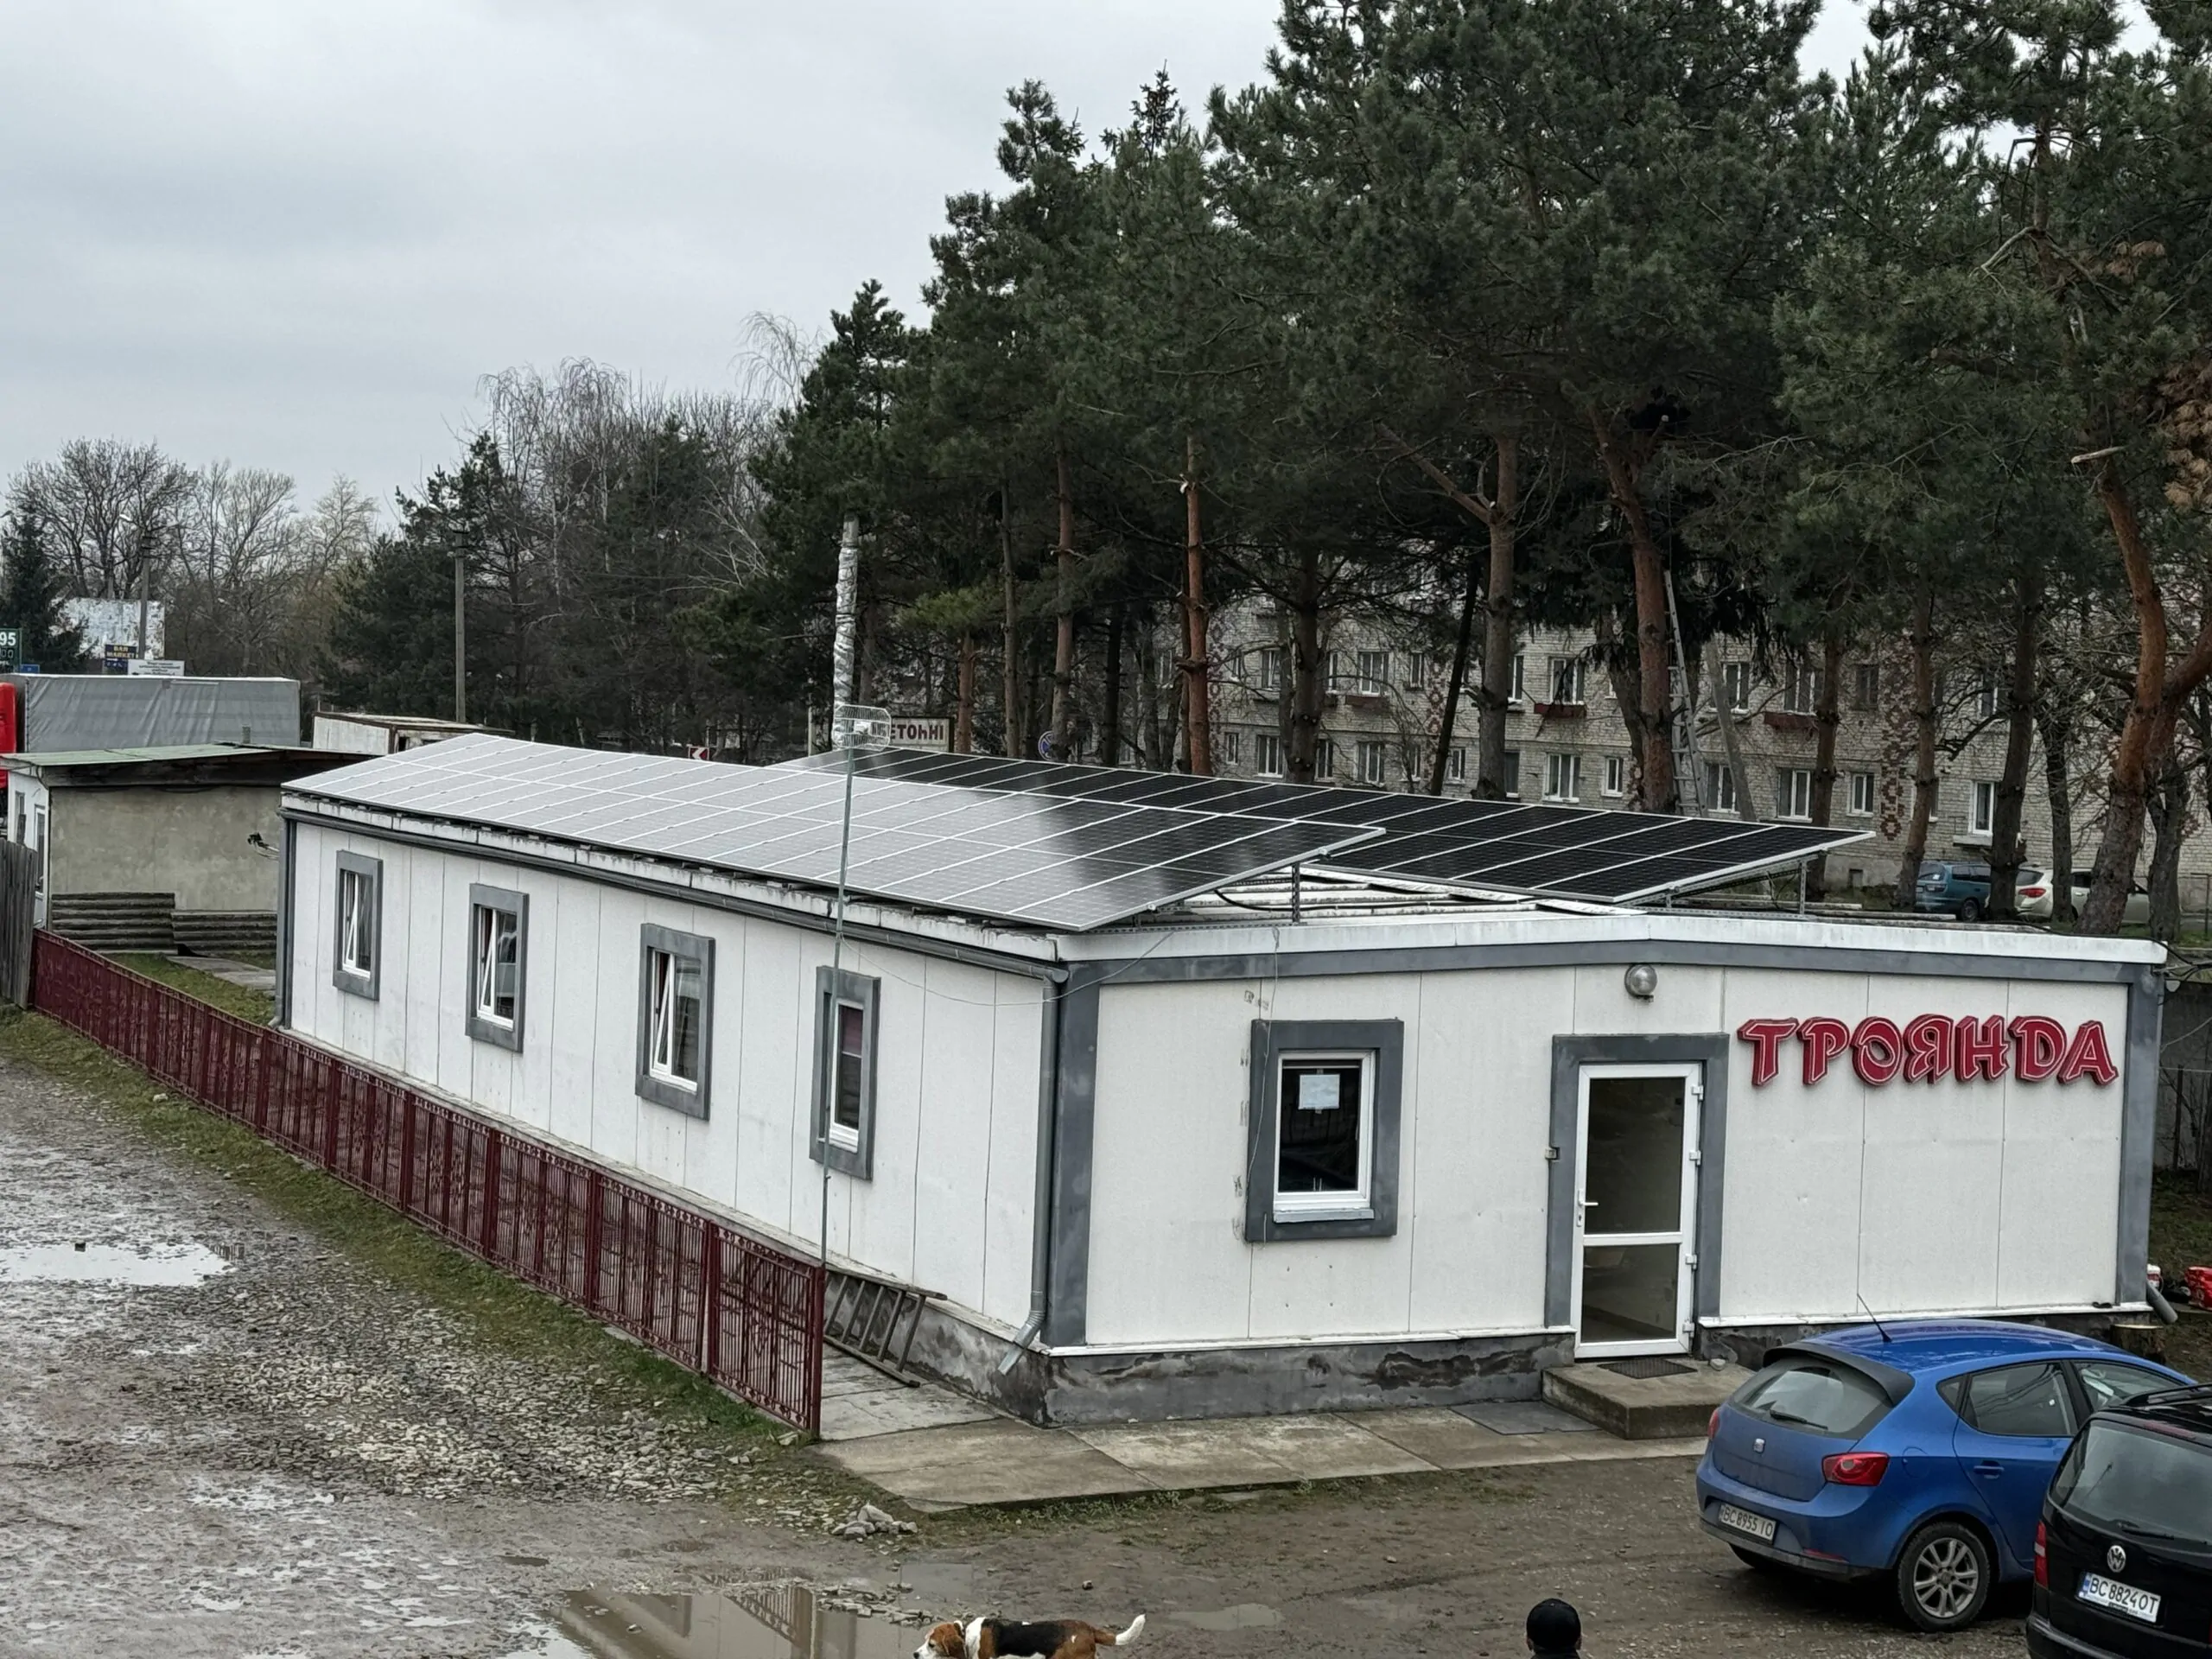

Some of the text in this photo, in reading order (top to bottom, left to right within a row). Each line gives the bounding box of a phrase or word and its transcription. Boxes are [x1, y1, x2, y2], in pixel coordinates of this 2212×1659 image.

[0, 632, 16, 646] 95
[1737, 1013, 2120, 1088] ТРОЯНДА
[2089, 1578, 2108, 1596] BC
[2109, 1585, 2138, 1607] 8824
[2139, 1595, 2158, 1613] OT
